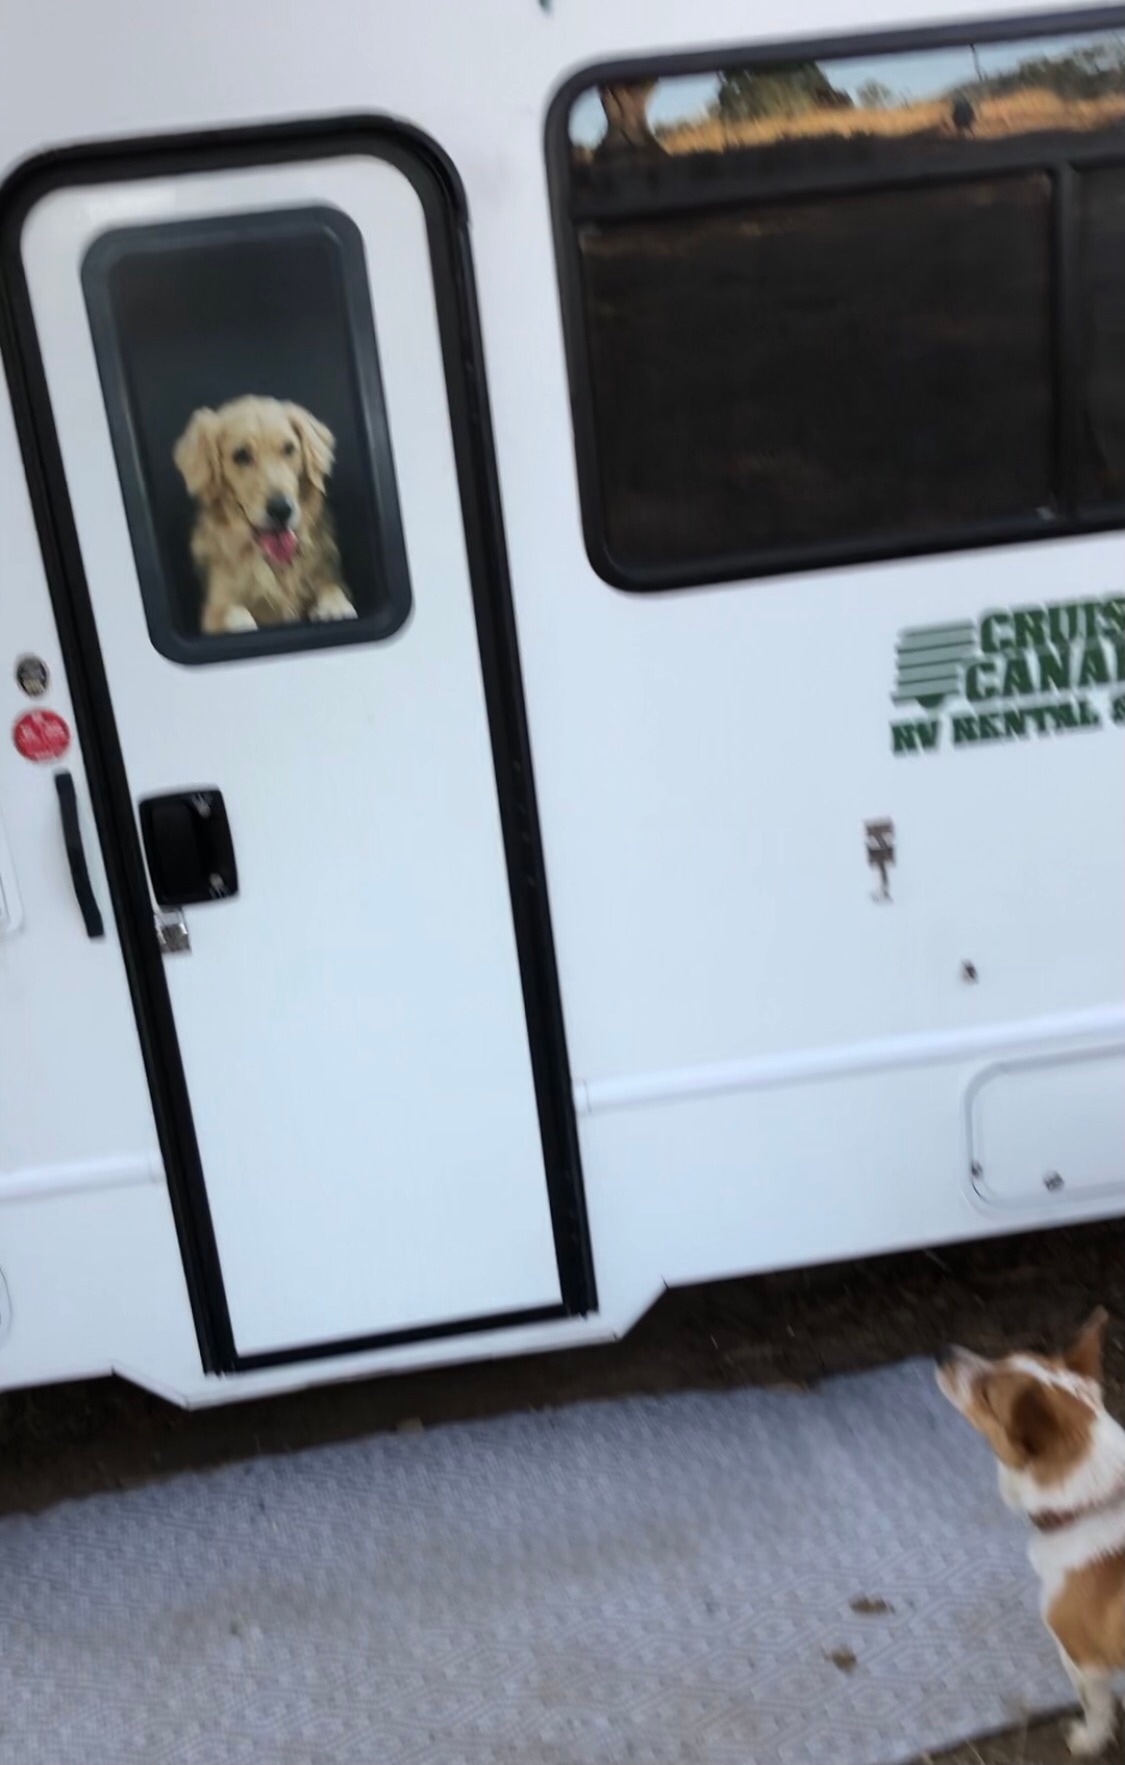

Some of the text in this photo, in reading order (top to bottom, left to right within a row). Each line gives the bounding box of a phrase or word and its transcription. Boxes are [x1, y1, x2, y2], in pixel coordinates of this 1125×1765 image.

[963, 637, 1125, 702] CANA
[890, 717, 941, 756] RV
[951, 698, 1103, 749] RENTAL
